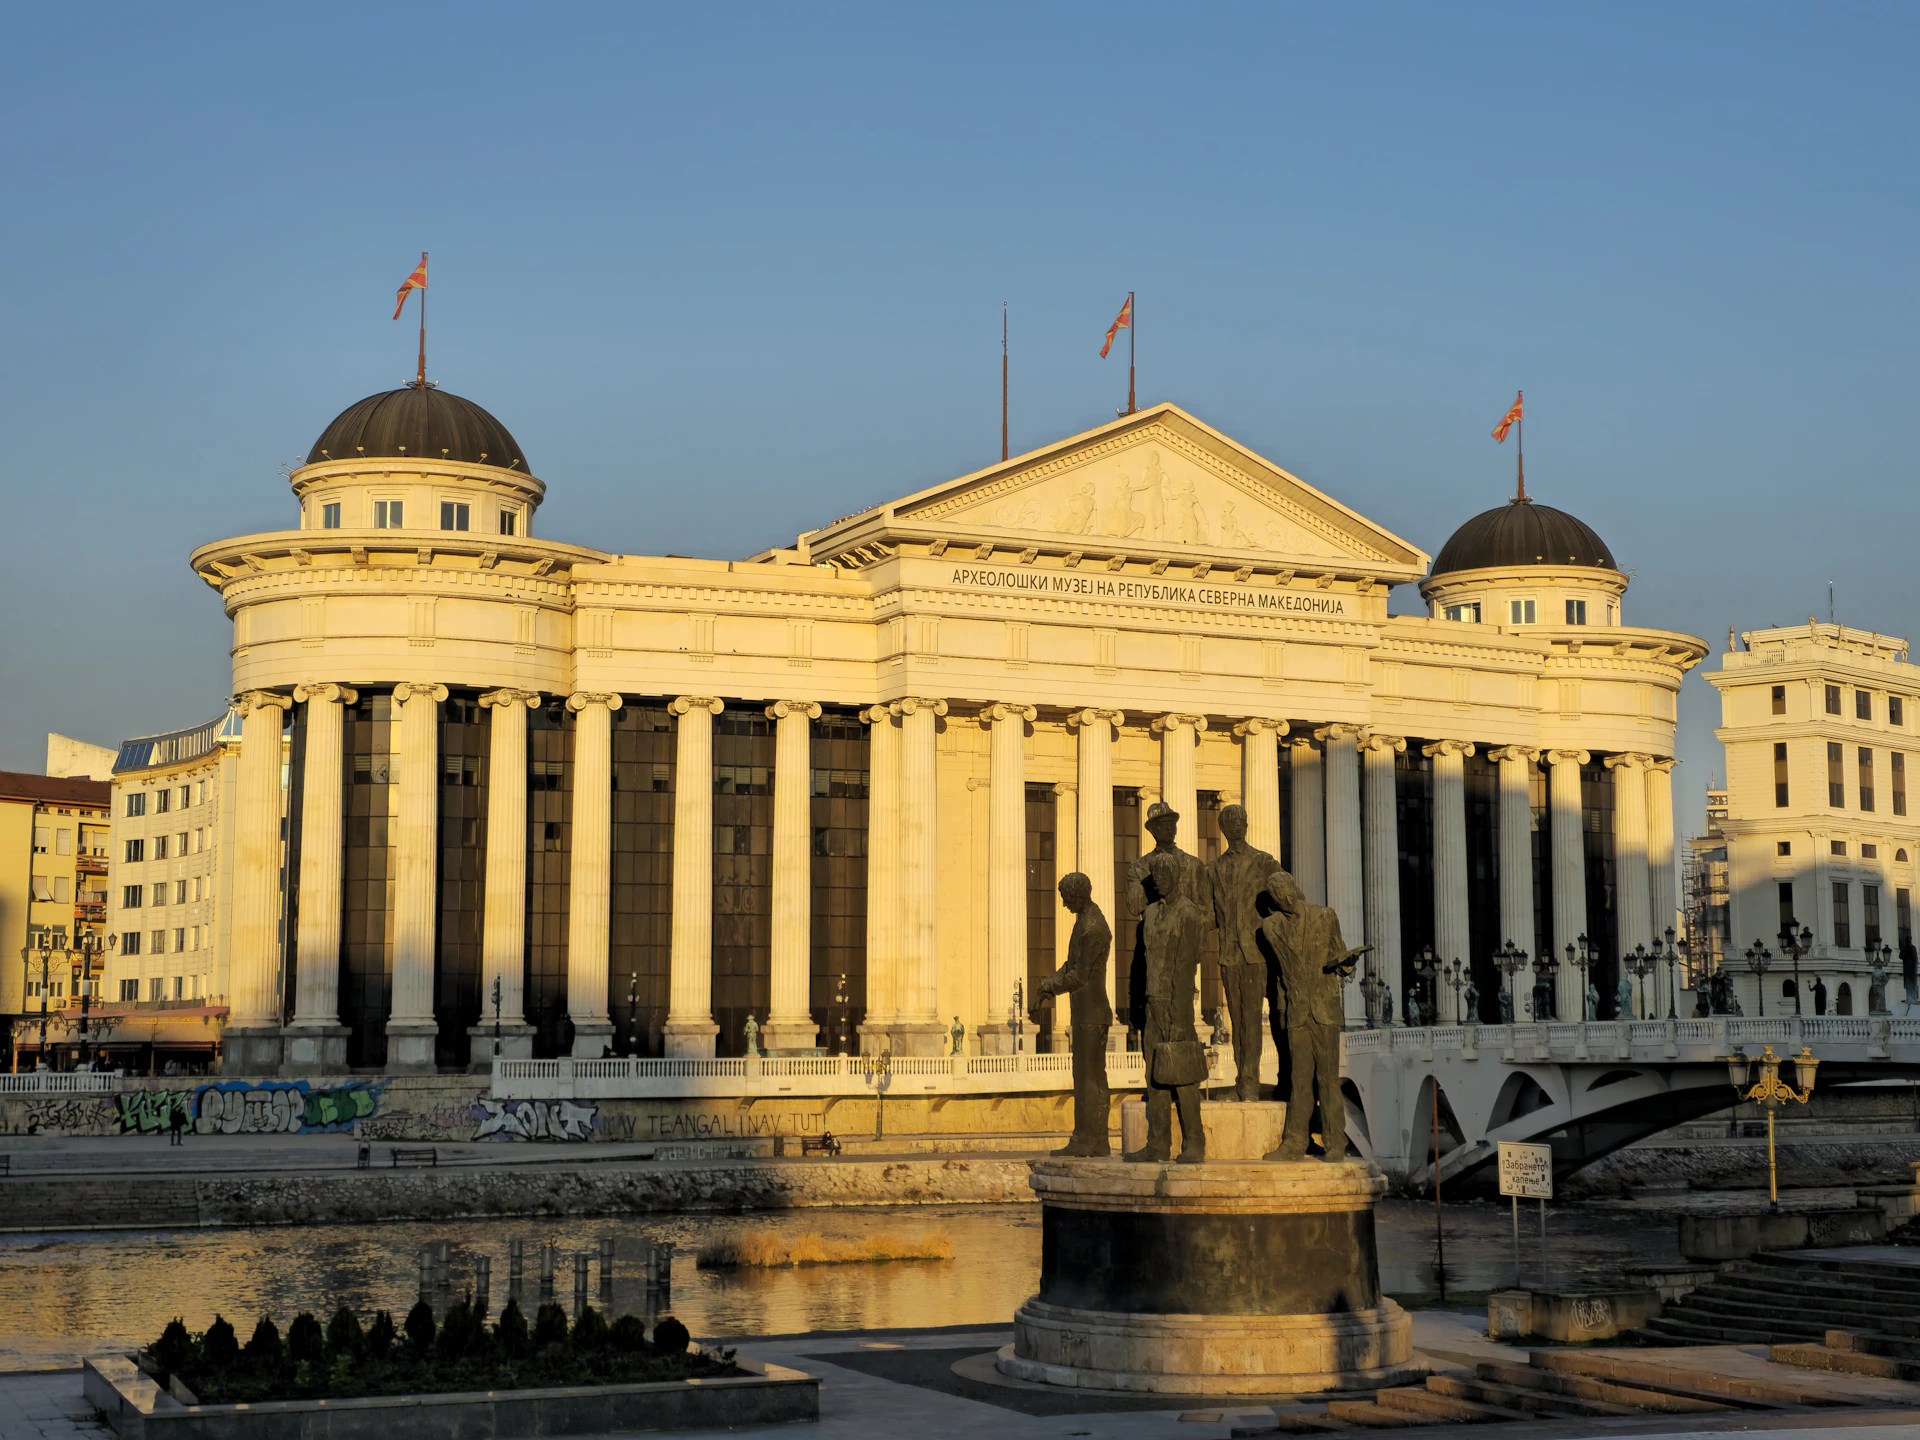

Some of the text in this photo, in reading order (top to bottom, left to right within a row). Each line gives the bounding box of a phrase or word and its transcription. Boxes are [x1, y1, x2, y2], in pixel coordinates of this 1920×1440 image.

[952, 569, 1344, 614] АРХЕОЛОШКИ МУЗЕЈ НА РЕПУБЛИКА СЕВЕРНА МАКЕДОНИЈА
[1506, 1159, 1545, 1172] Забрането
[1512, 1176, 1540, 1186] капење
